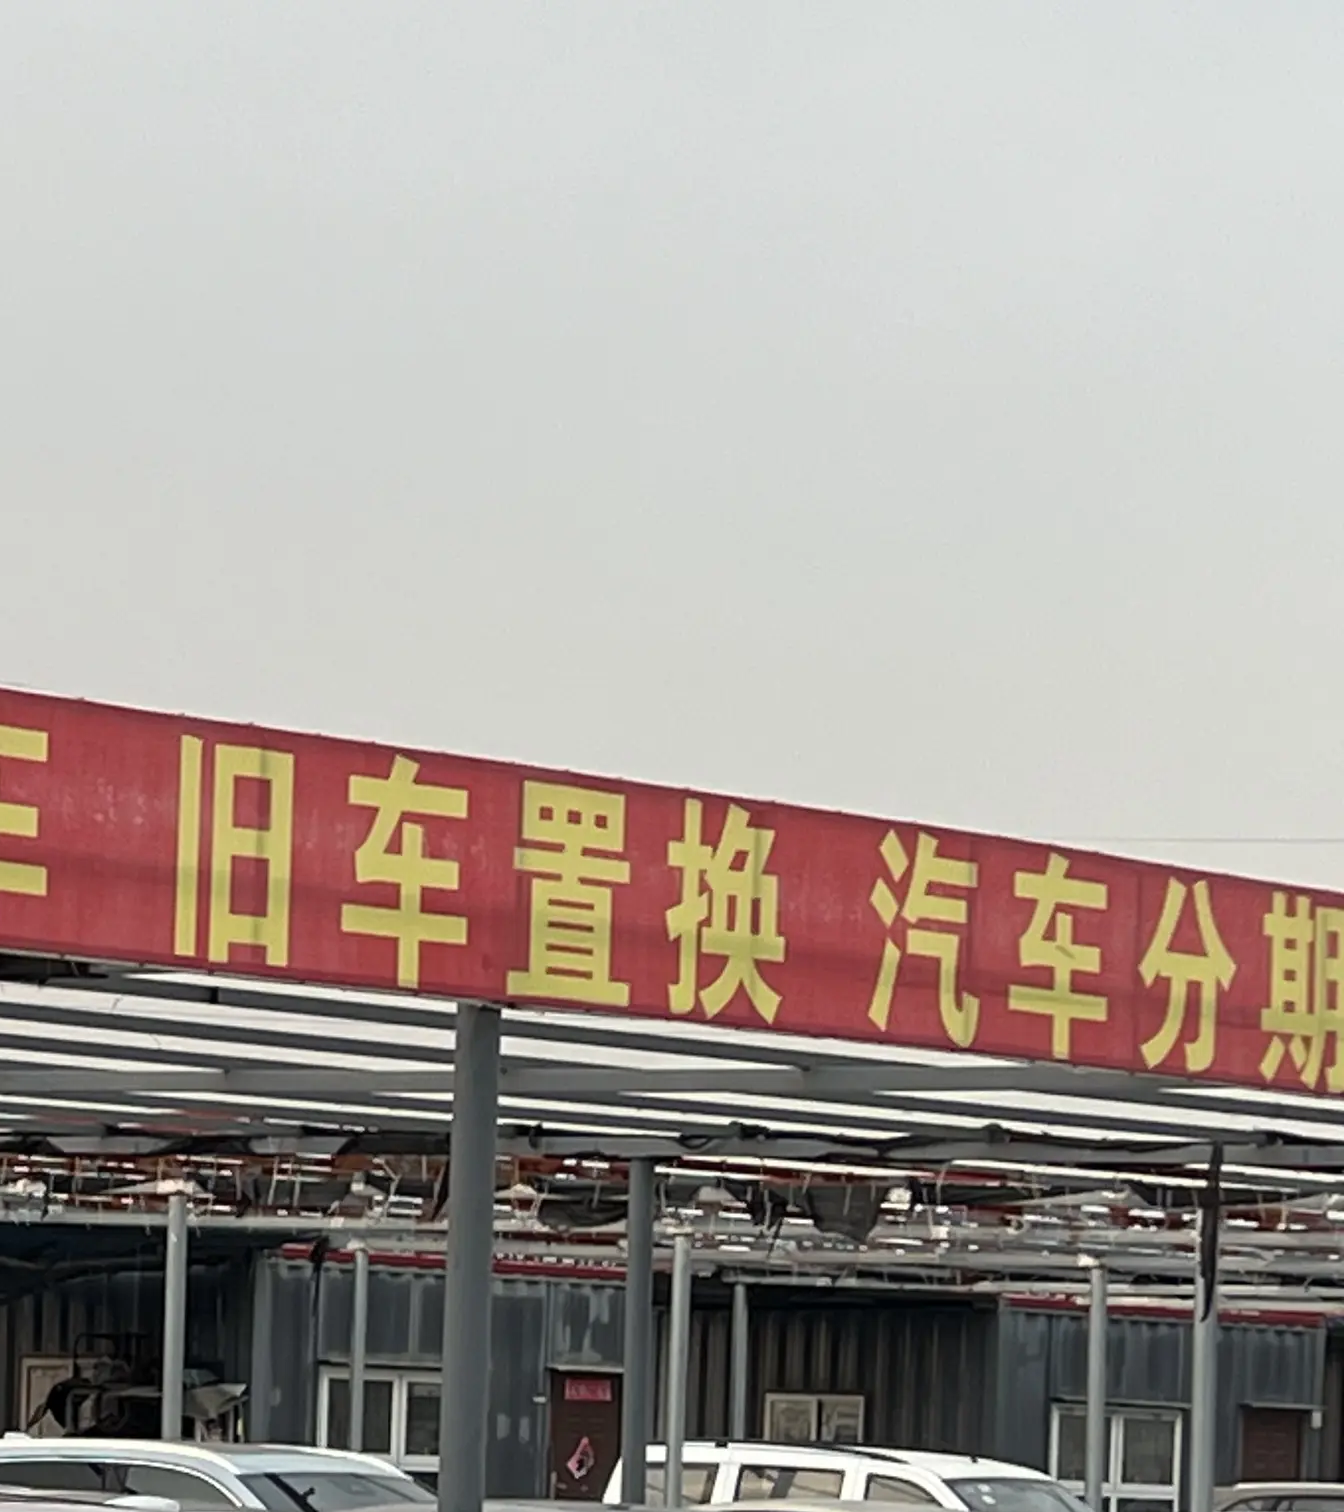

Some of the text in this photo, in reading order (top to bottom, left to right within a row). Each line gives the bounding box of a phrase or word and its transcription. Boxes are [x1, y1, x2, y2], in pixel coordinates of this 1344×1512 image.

[174, 734, 786, 1023] 旧车置换
[867, 830, 1344, 1093] 汽车分期
